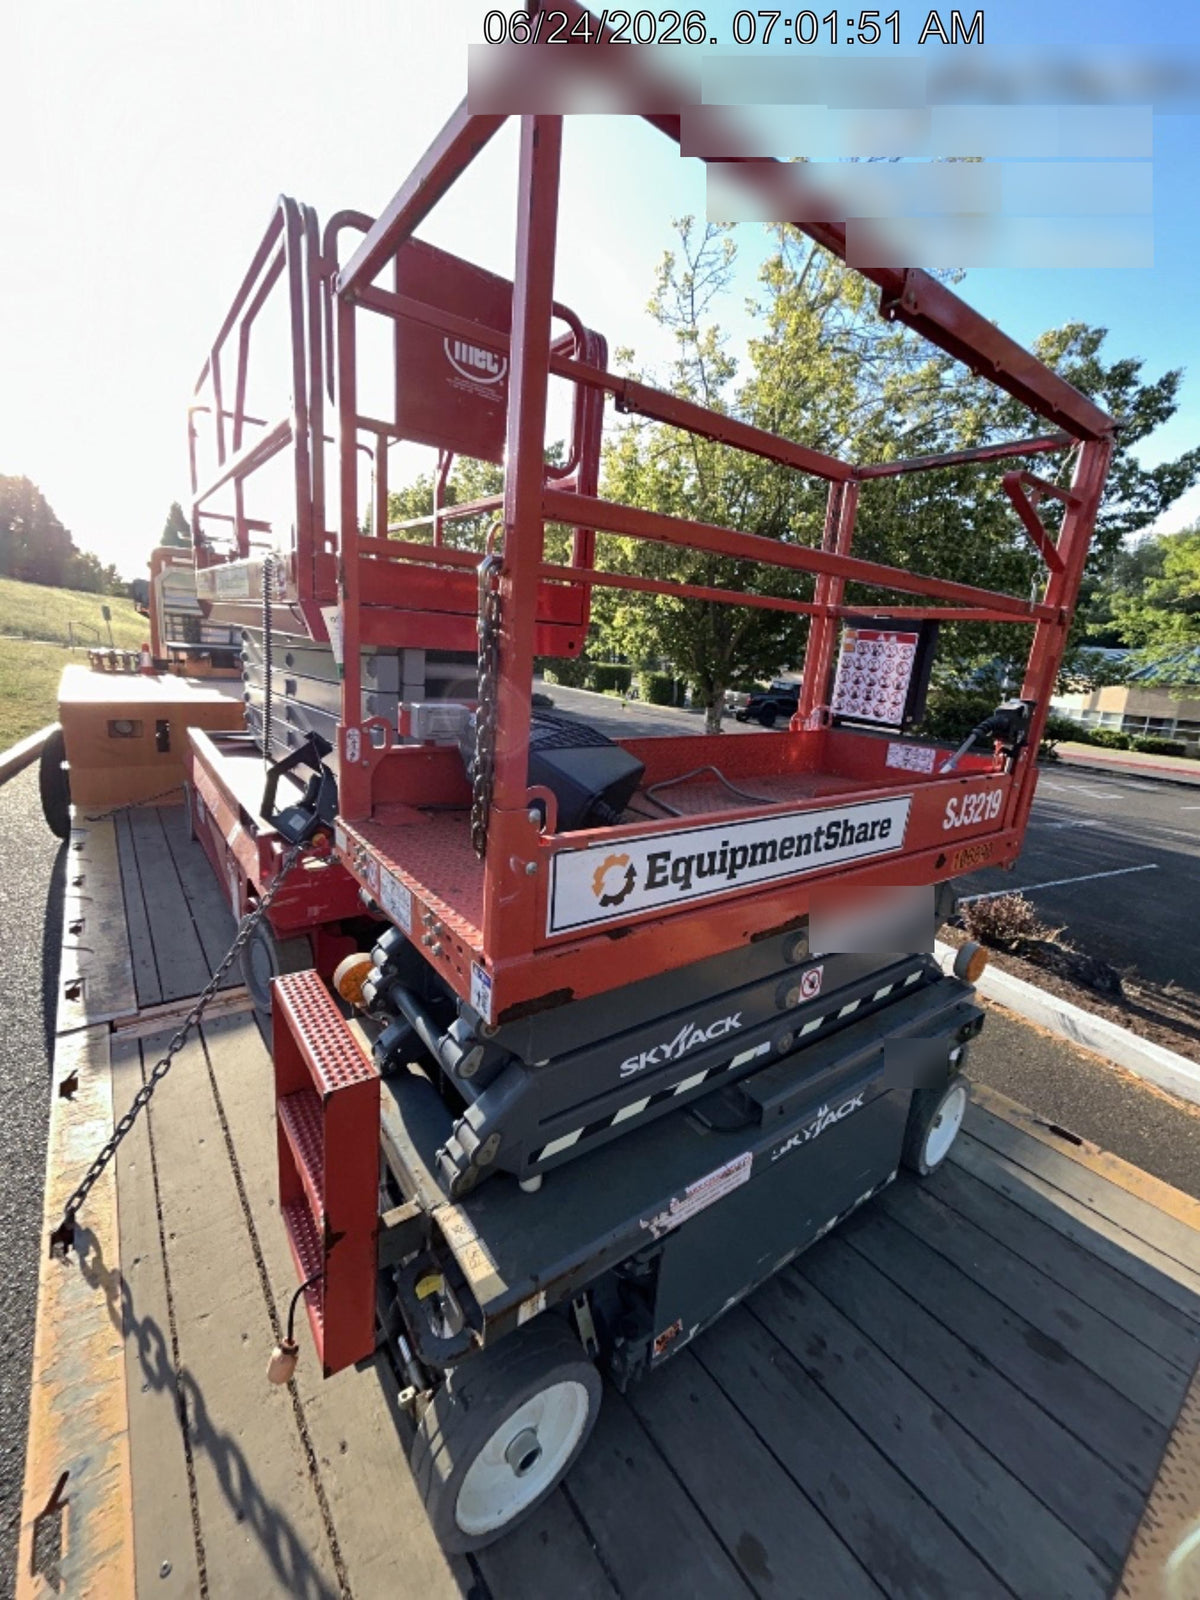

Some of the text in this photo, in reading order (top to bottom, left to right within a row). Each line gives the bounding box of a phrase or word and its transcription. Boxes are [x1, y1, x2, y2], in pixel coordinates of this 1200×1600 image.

[942, 788, 1002, 830] SJ3219
[643, 817, 893, 892] EquipmentShare
[619, 1011, 743, 1078] SKYJACK
